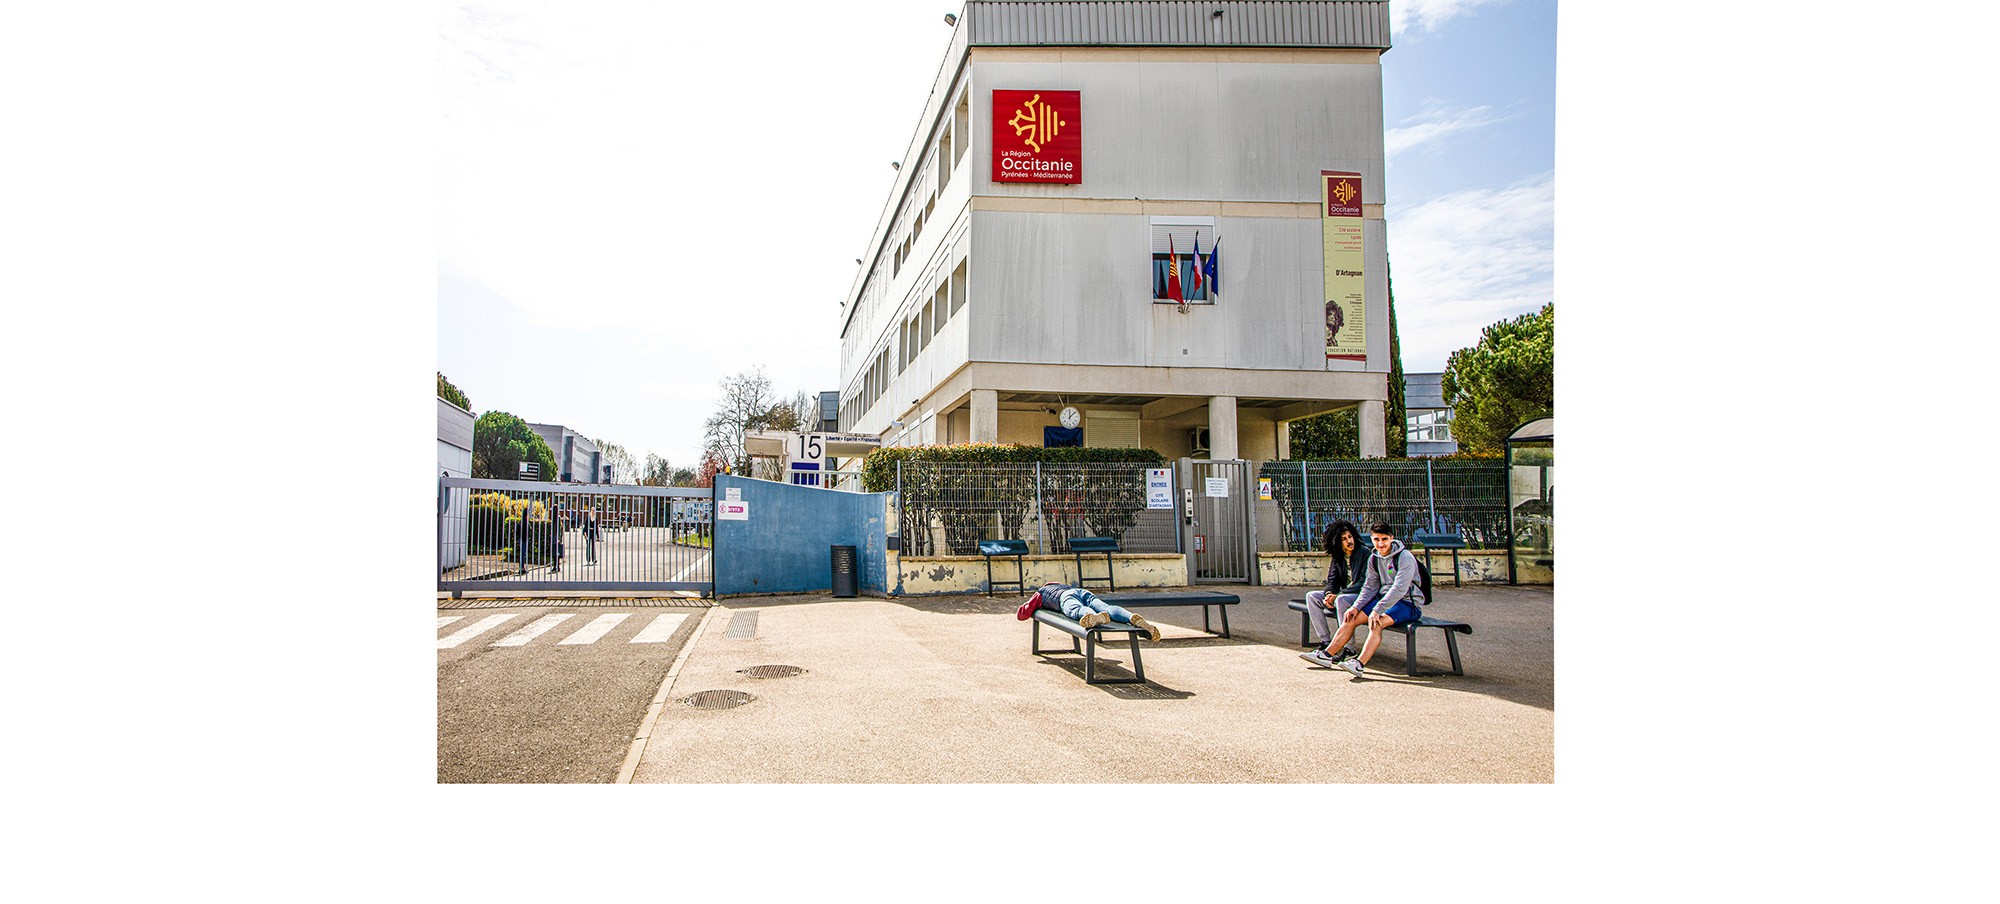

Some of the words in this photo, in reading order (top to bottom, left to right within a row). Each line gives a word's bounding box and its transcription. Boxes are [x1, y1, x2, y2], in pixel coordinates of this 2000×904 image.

[1010, 150, 1031, 158] Région
[1001, 157, 1073, 171] Occitanie
[1033, 171, 1074, 179] Méditerranée
[1335, 269, 1363, 277] D'Artagnan
[799, 435, 822, 459] 15
